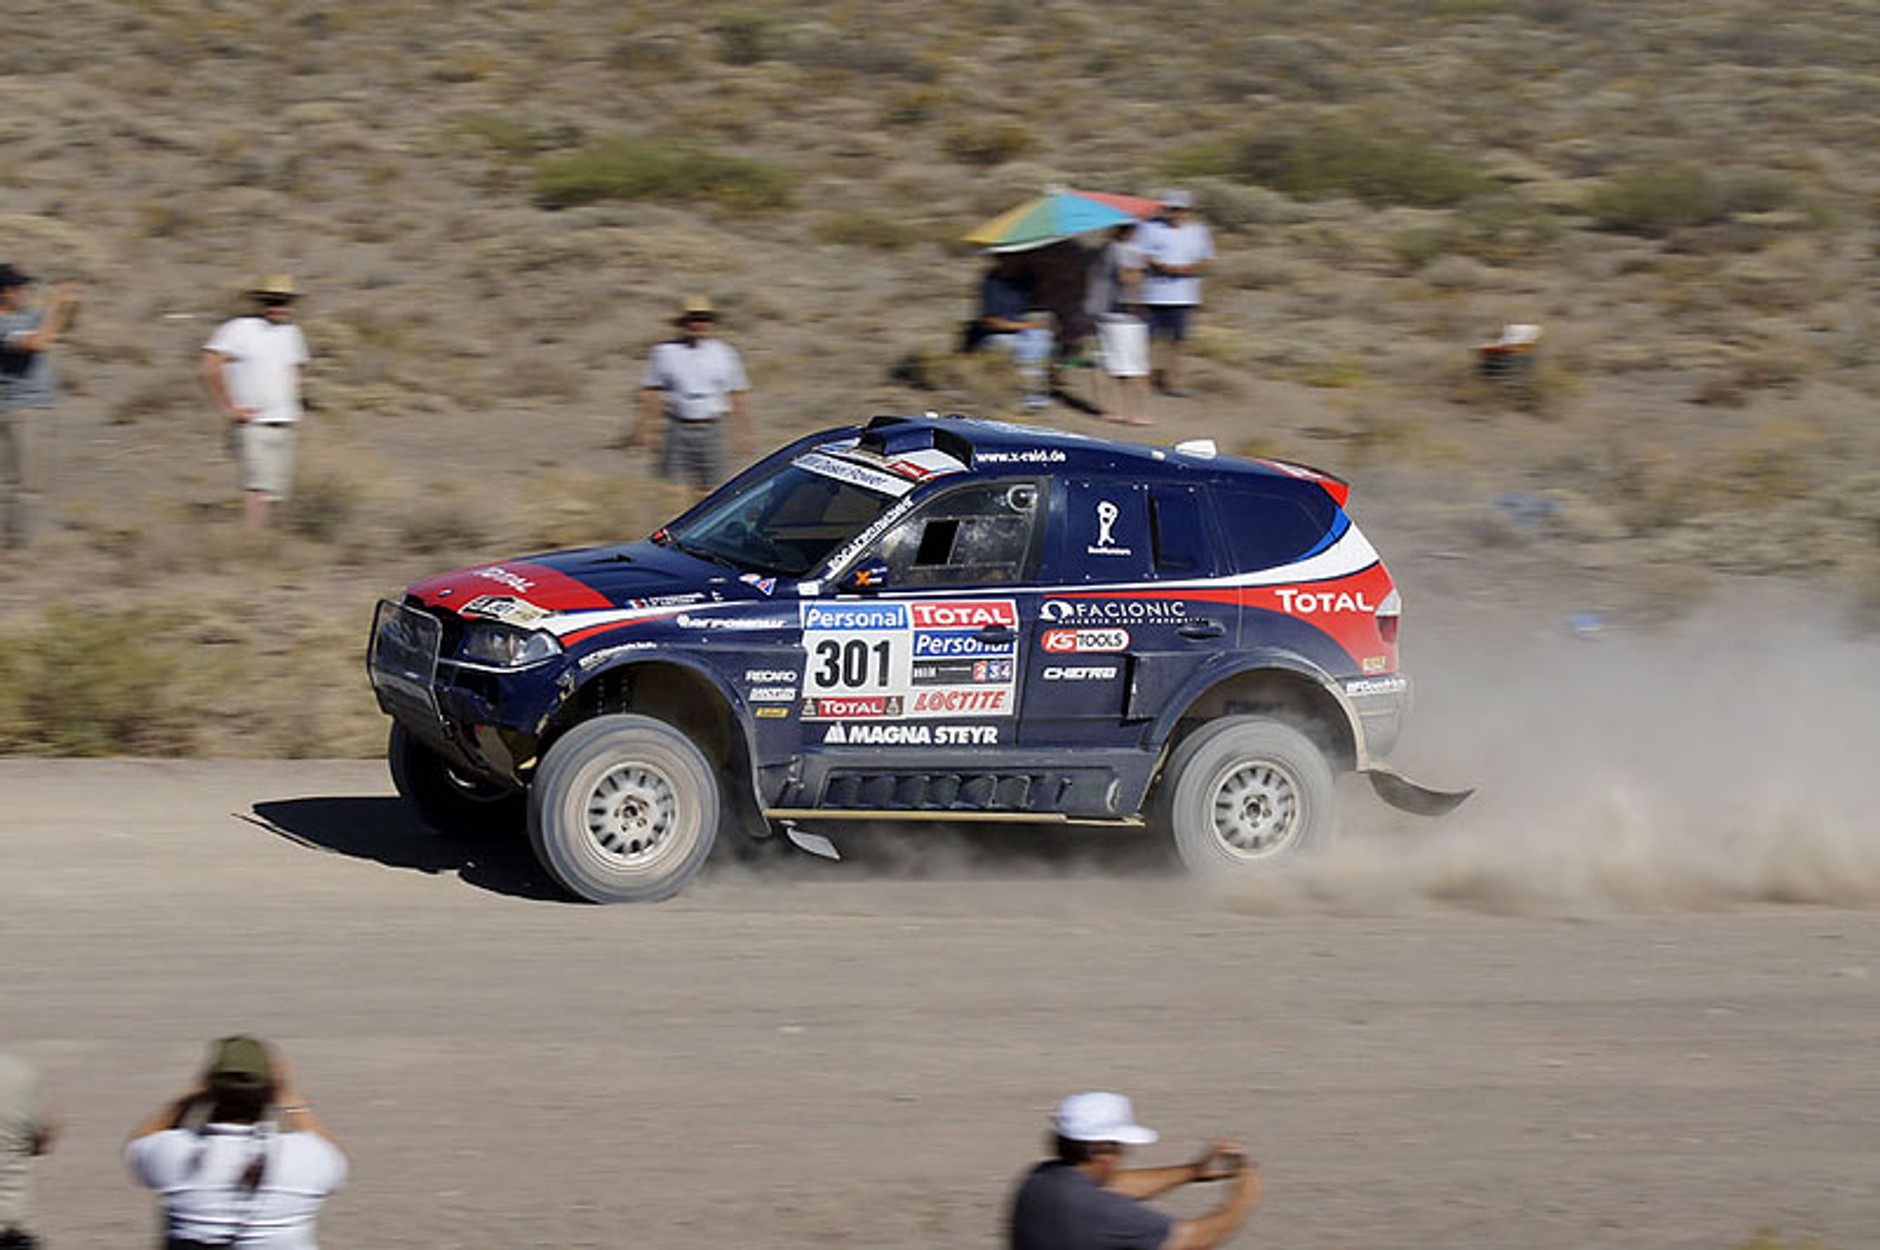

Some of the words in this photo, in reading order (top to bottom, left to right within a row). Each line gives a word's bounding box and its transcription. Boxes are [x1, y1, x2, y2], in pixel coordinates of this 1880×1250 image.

[1076, 602, 1186, 617] FACIONIC
[1275, 589, 1375, 613] TOTAL
[807, 608, 904, 627] Personal
[914, 606, 1012, 624] TOTAL
[815, 639, 891, 687] 301
[821, 700, 884, 715] TOTAL
[914, 690, 1006, 711] LOCTITE
[849, 725, 932, 744] MAGNA
[934, 725, 999, 744] STEYR
